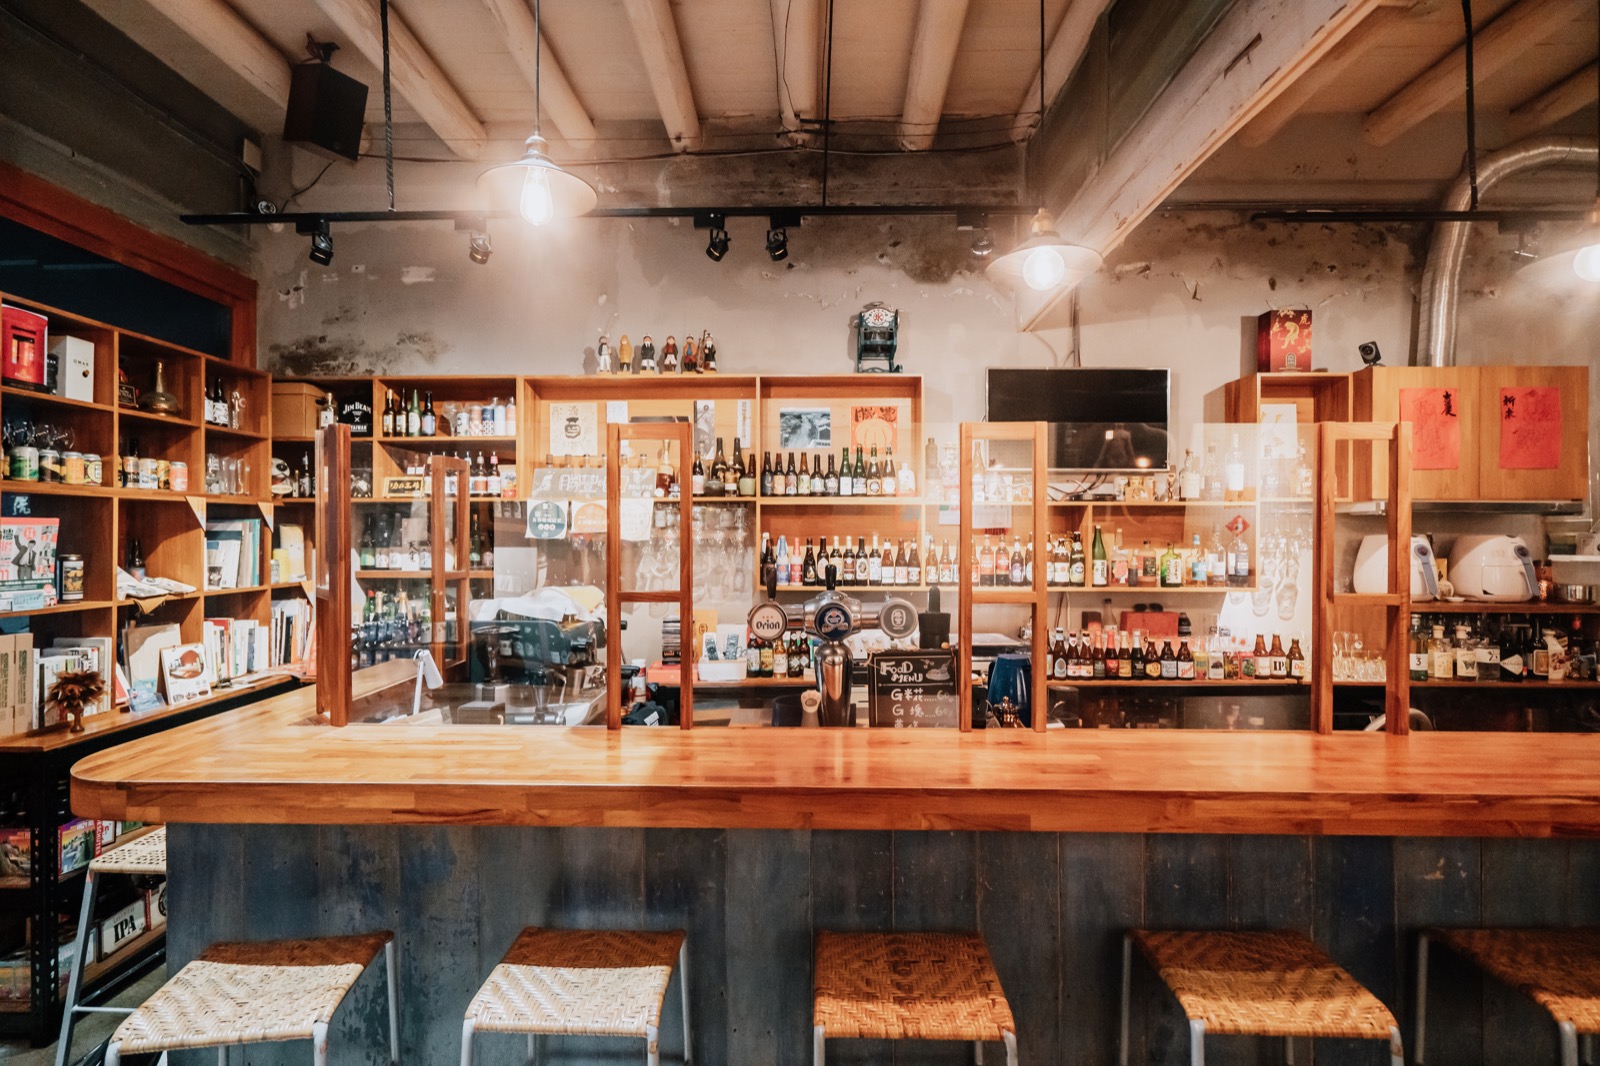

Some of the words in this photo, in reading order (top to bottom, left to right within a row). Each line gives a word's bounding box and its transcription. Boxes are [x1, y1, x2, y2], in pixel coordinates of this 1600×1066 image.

[73, 358, 90, 367] OMAR
[755, 619, 781, 631] Orion
[113, 914, 137, 944] IPA
